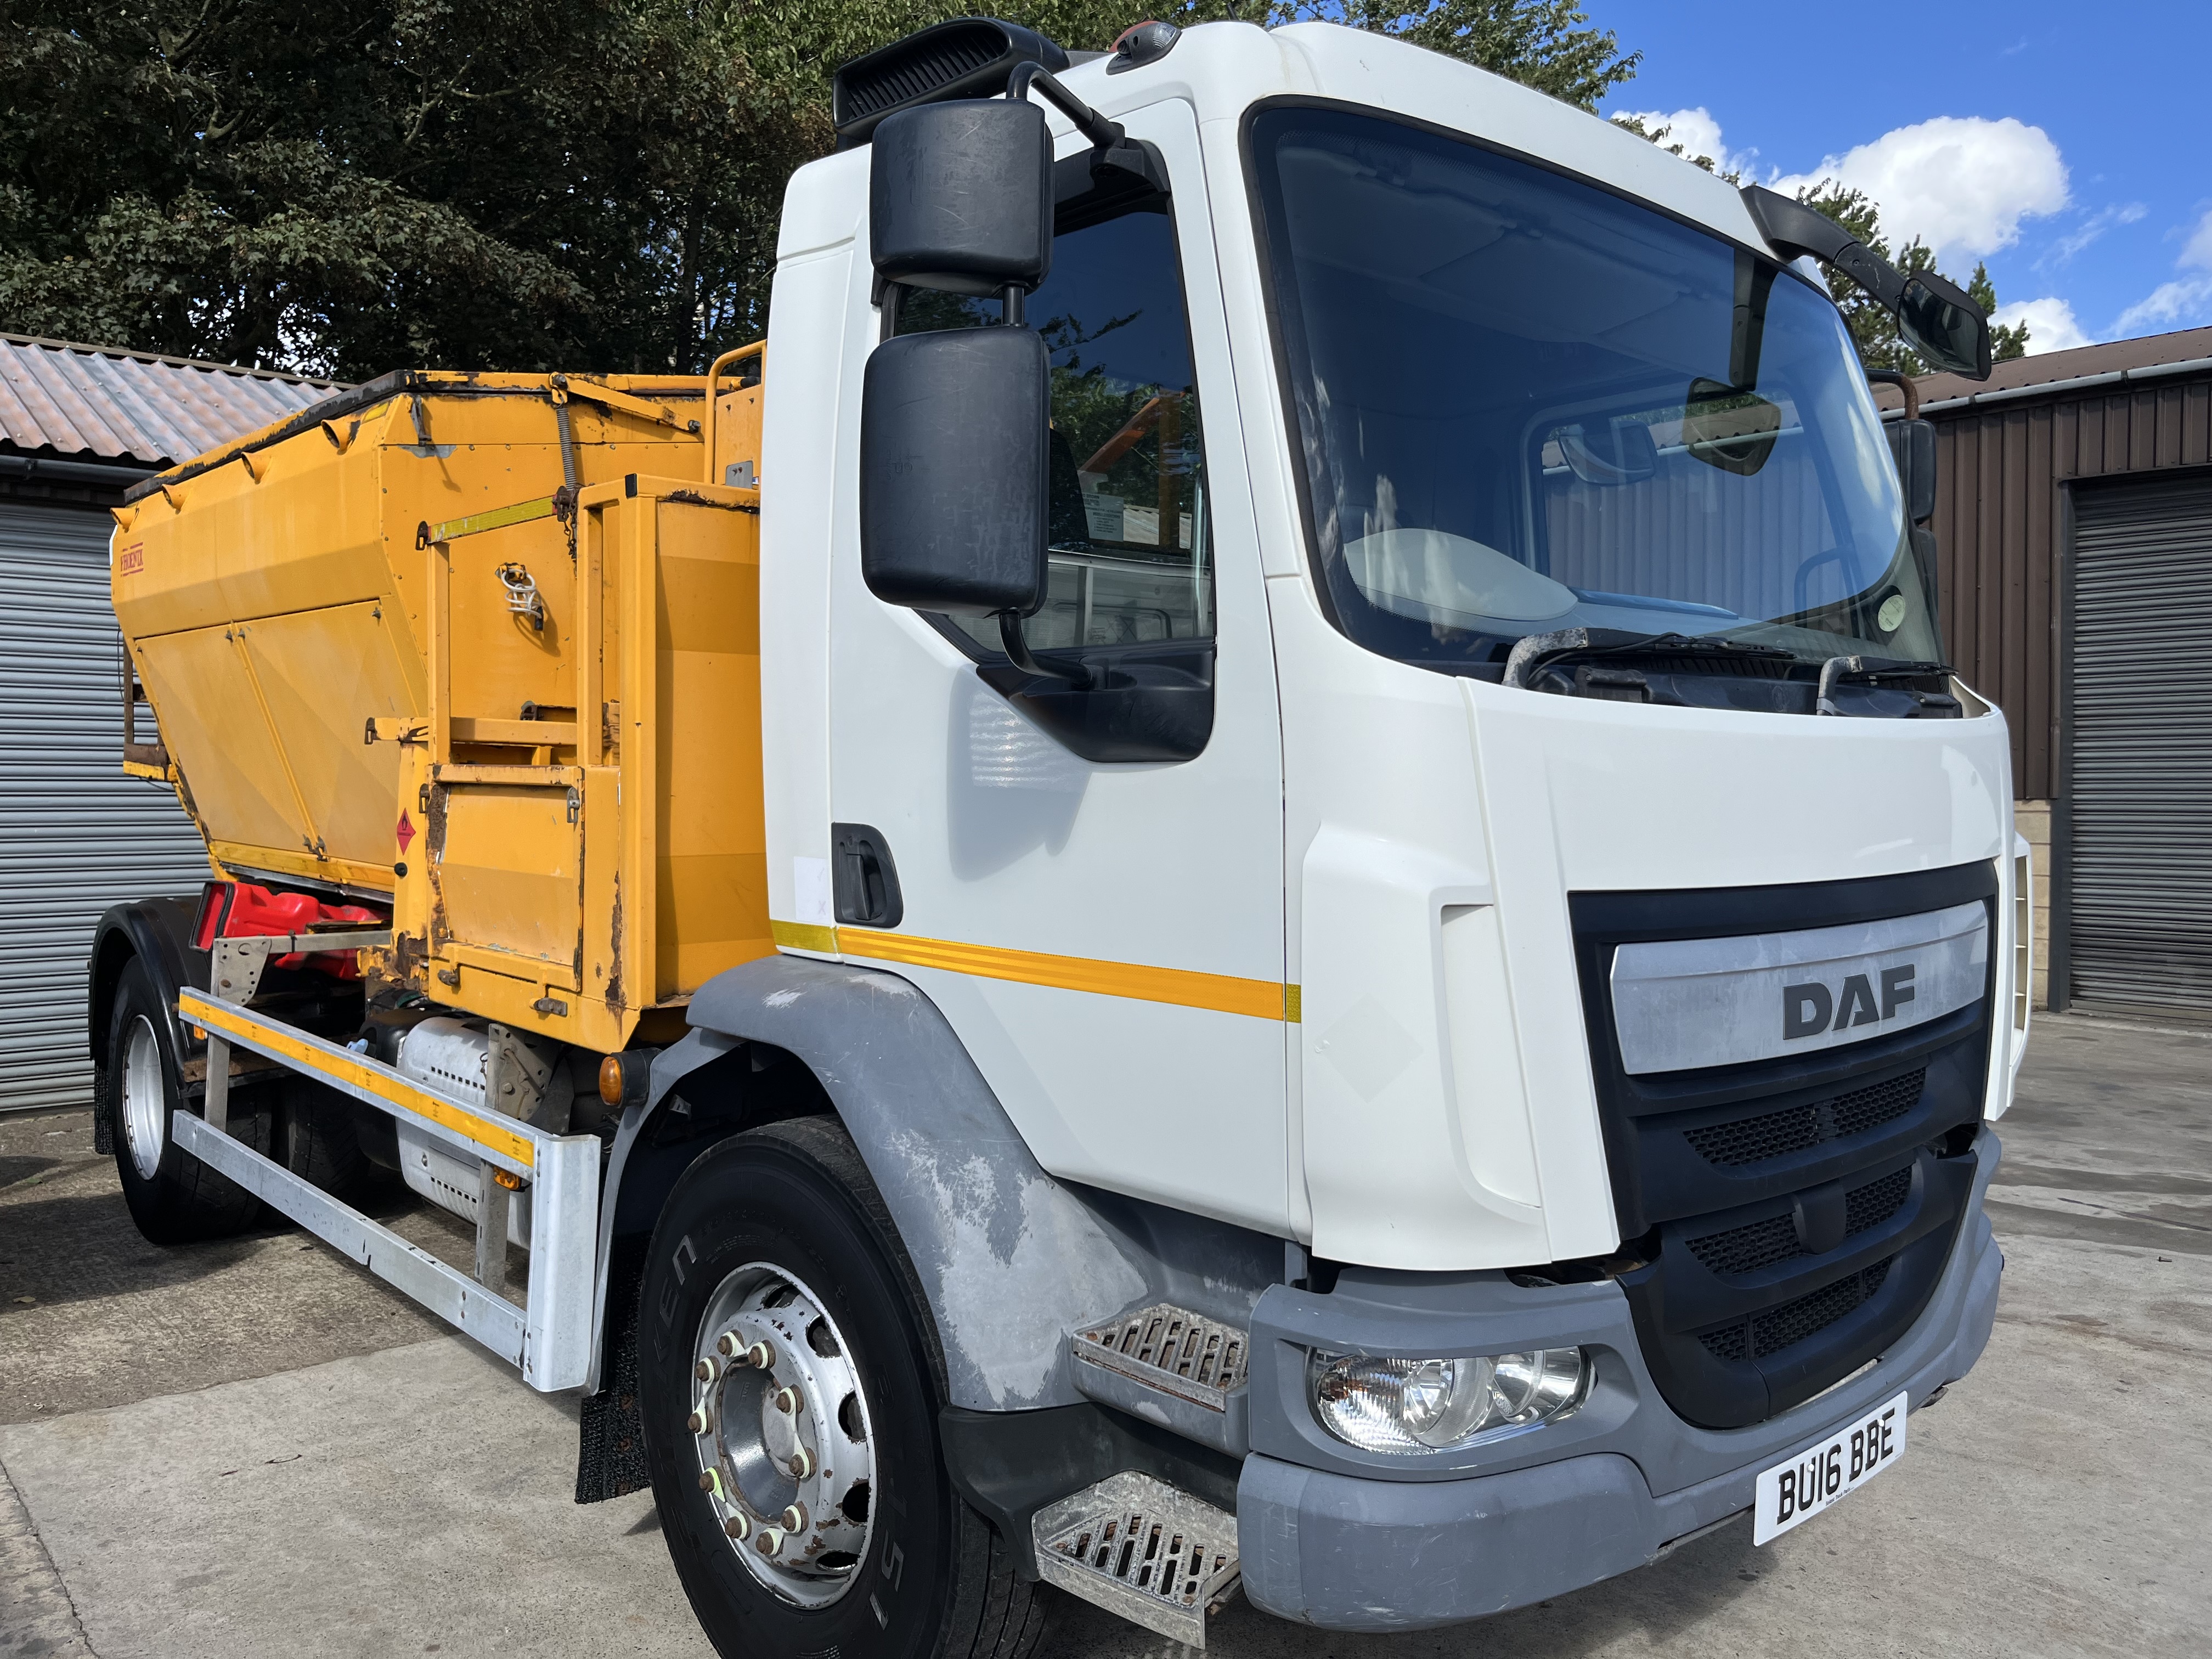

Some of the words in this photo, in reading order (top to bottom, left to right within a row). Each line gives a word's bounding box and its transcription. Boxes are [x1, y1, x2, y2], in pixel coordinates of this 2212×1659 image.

[1782, 964, 1915, 1040] DAF
[1777, 1444, 1841, 1525] BU16
[1849, 1408, 1895, 1482] BBE
